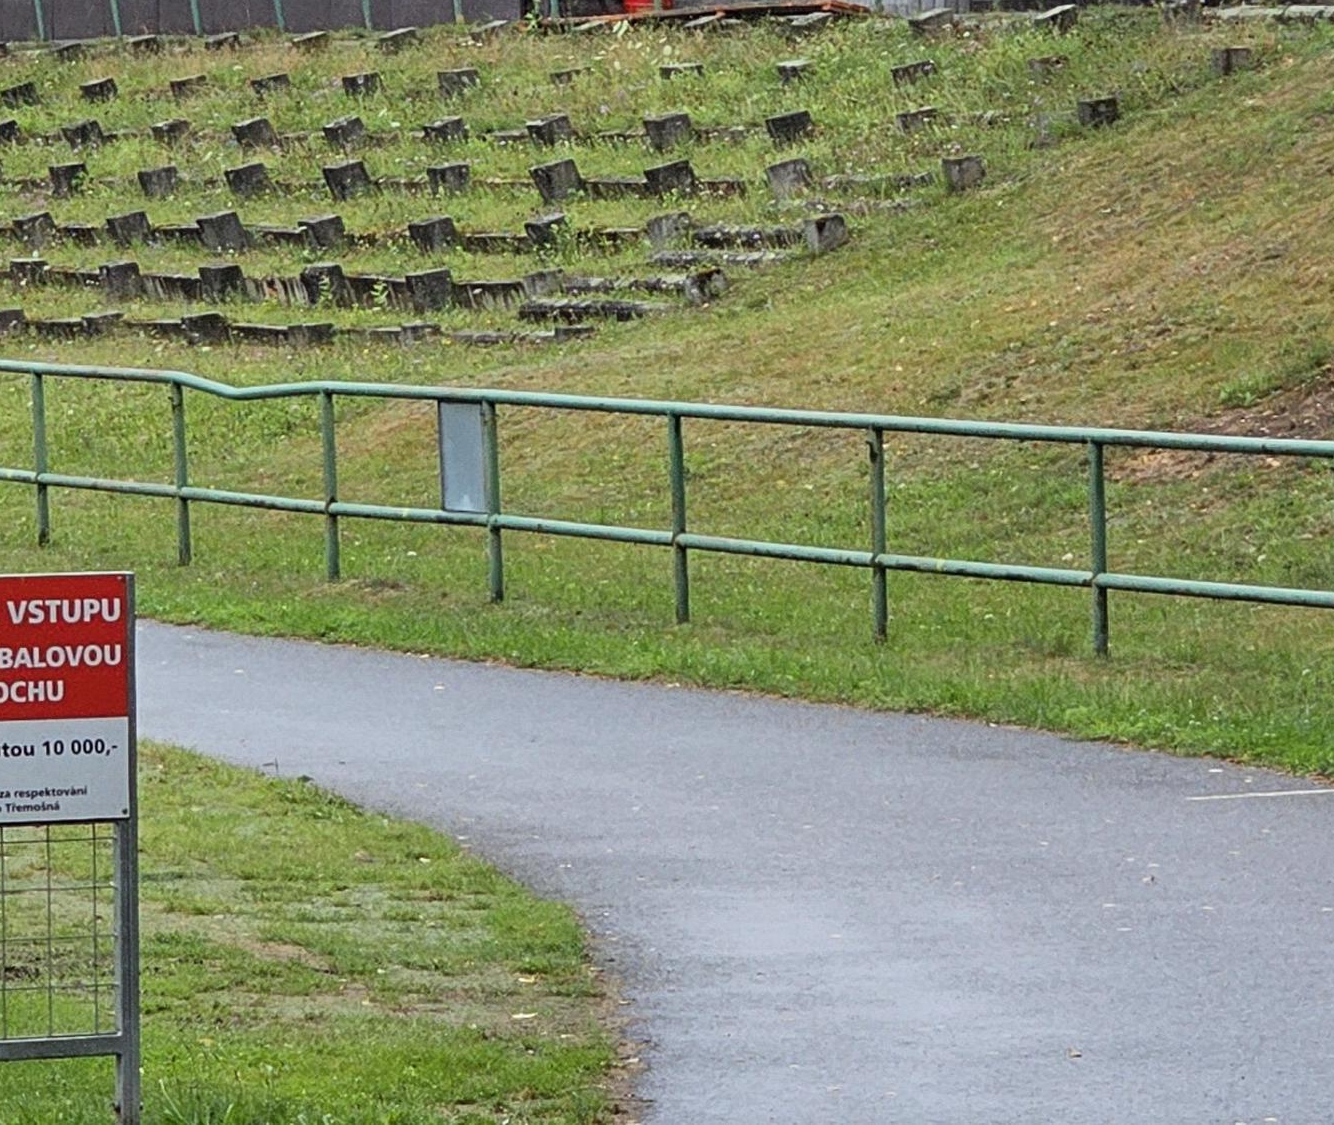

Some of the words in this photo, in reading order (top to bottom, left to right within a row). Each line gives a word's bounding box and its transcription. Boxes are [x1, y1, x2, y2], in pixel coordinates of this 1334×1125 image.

[7, 598, 121, 624] VSTUPU
[42, 740, 65, 755] 10
[71, 738, 118, 756] 000,-
[0, 790, 11, 798] za
[14, 785, 87, 799] respektování
[5, 801, 60, 813] Třemošná
